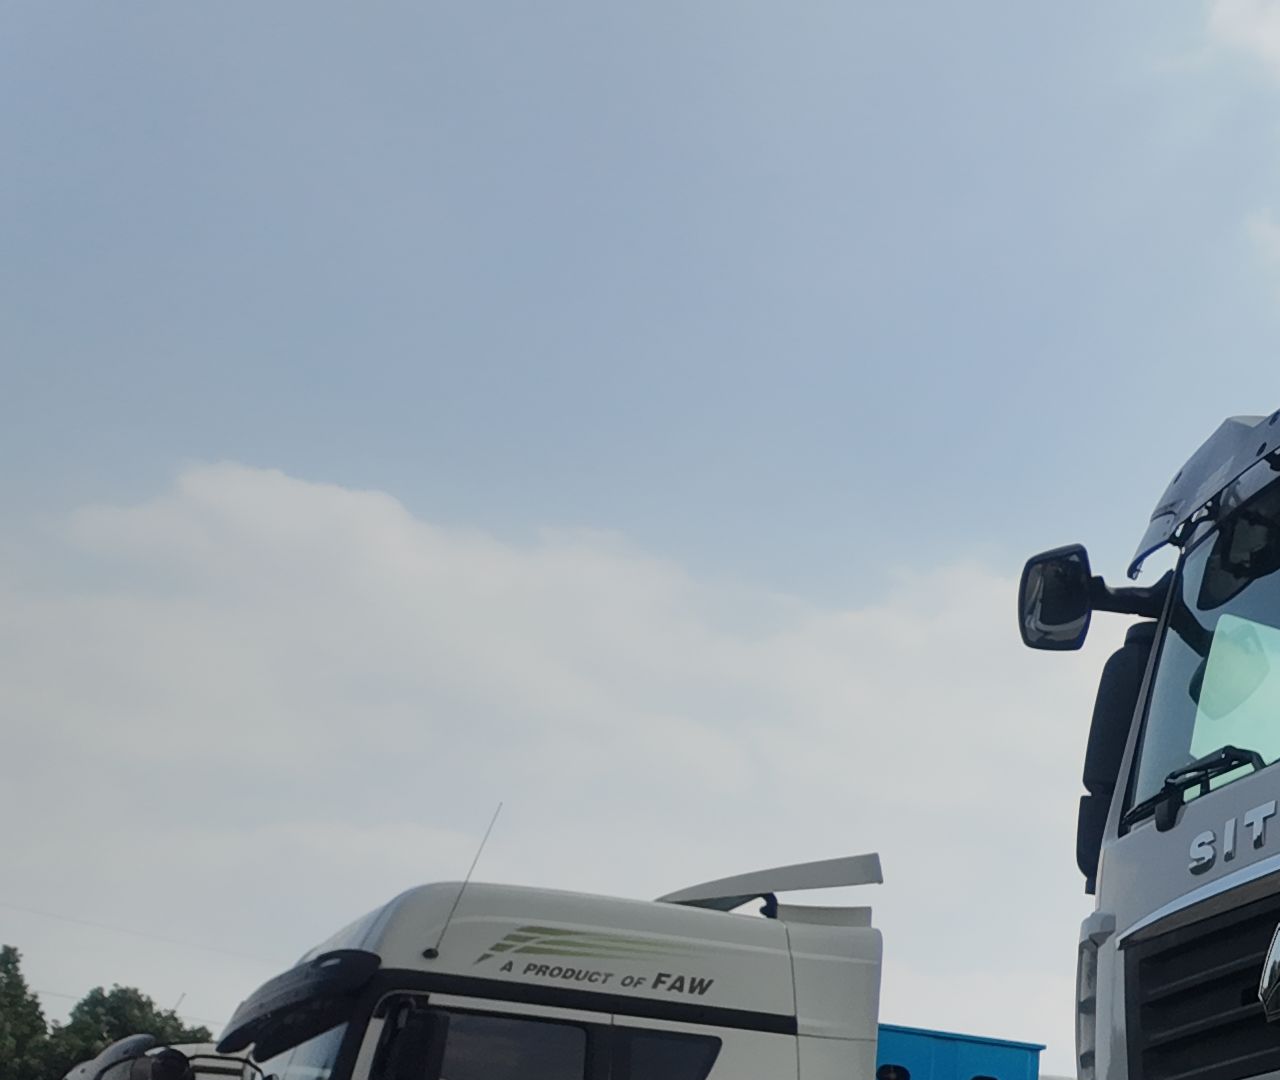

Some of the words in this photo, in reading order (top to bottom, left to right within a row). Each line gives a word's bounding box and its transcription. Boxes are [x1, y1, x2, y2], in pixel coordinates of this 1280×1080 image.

[500, 960, 513, 973] A
[522, 963, 614, 985] PRODUCT
[620, 975, 647, 990] OF
[651, 972, 714, 996] FAW
